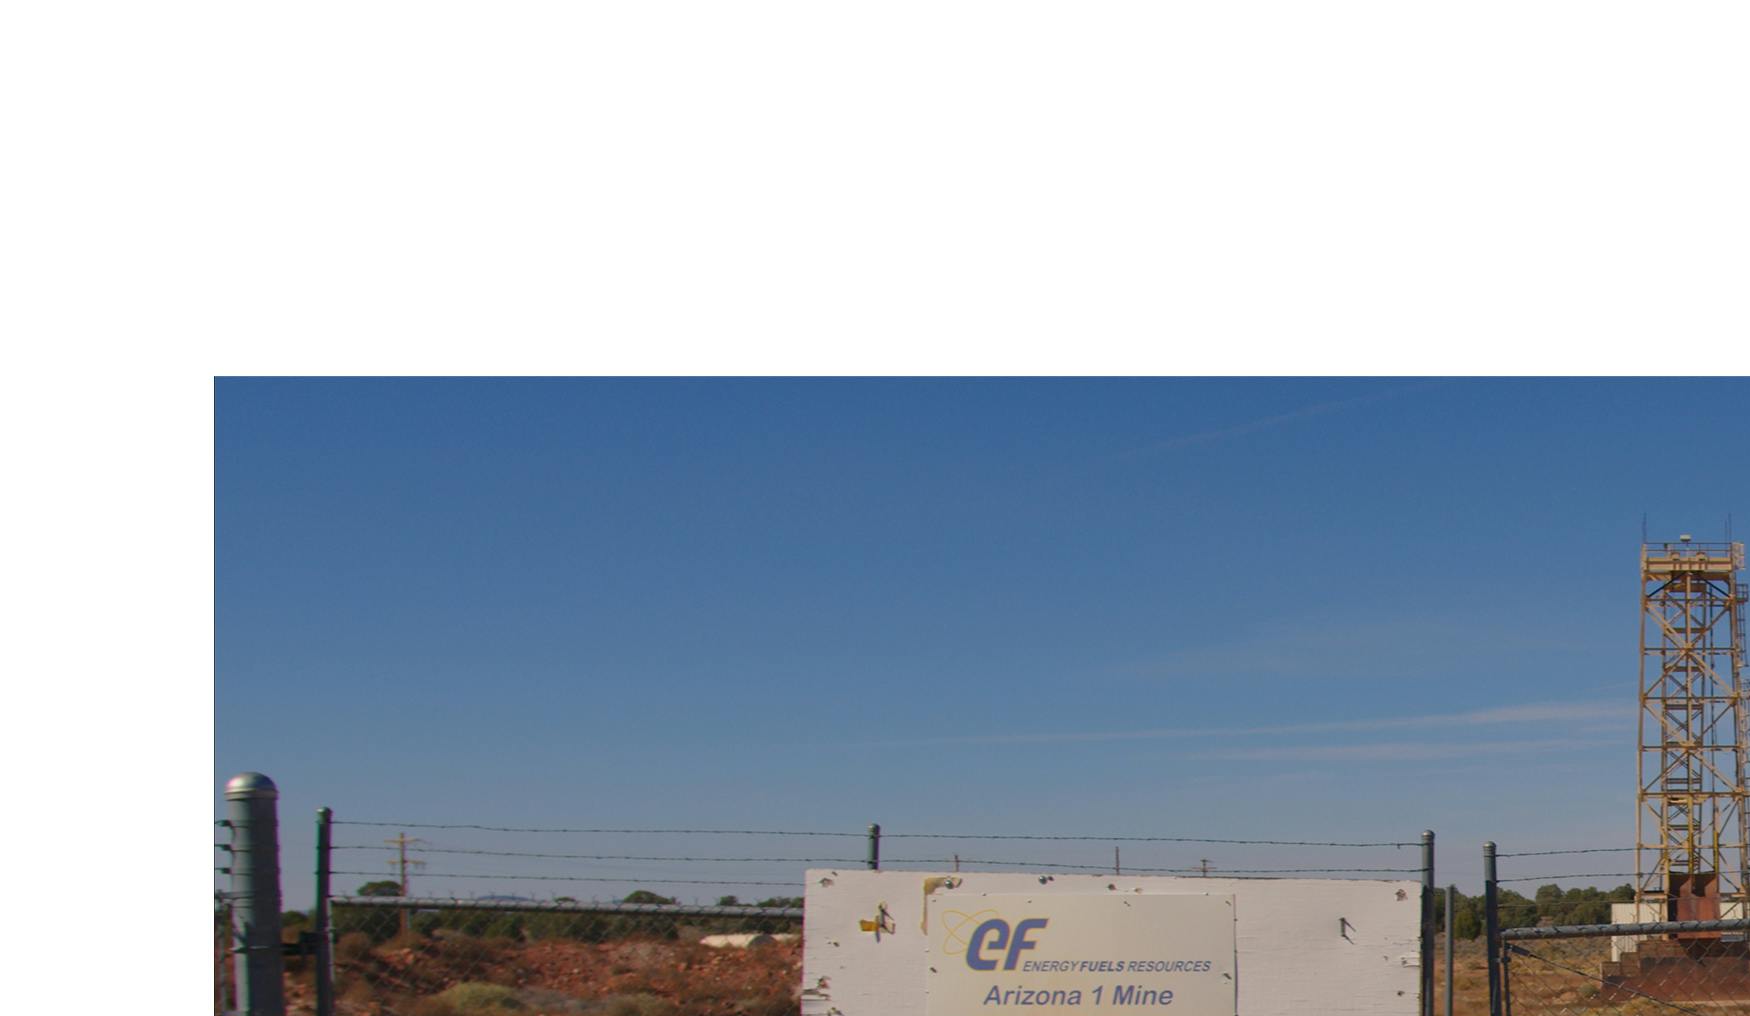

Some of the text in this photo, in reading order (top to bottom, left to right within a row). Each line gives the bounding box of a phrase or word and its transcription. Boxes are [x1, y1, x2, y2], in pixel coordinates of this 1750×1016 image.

[1126, 960, 1212, 972] RESOURCES
[982, 984, 1174, 1006] Arizona 1 Mine
